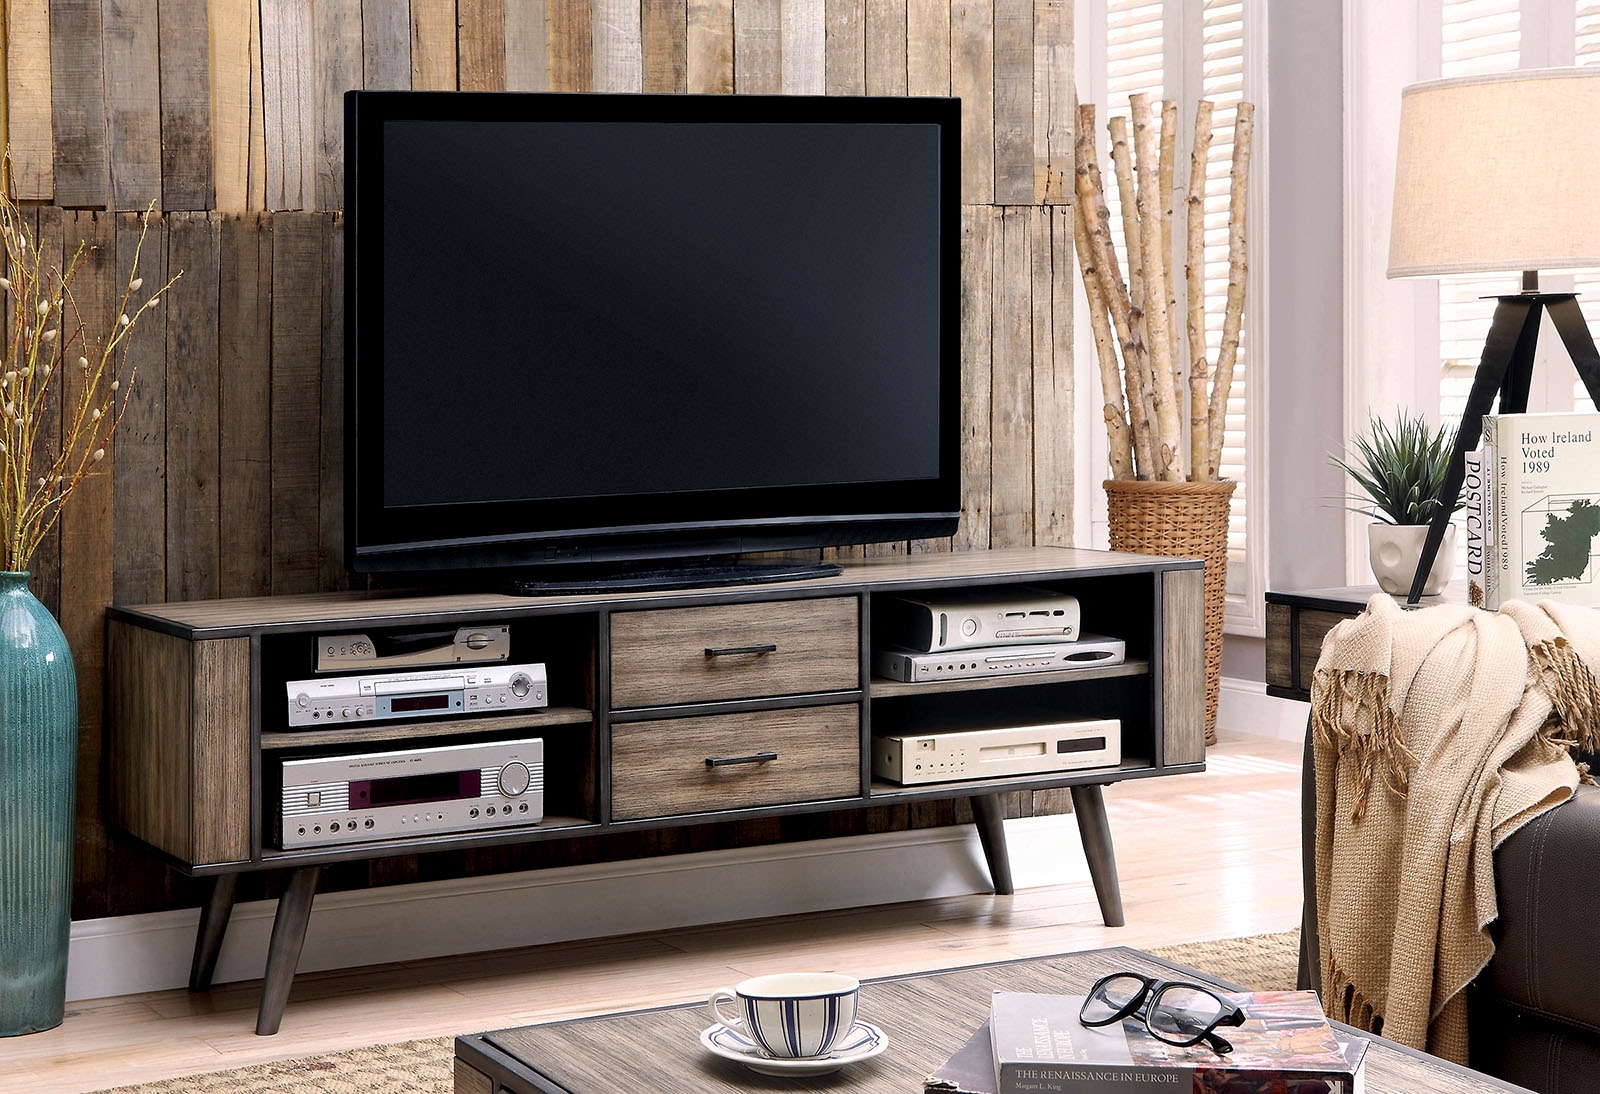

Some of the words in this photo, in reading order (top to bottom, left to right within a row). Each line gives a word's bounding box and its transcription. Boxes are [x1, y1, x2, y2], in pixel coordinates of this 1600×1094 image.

[1521, 432, 1547, 444] How
[1552, 430, 1592, 443] Ireland
[1521, 446, 1555, 458] Voted
[1523, 460, 1550, 473] 1989
[1466, 460, 1483, 575] POSTCARD
[1015, 1069, 1038, 1079] THE
[1040, 1070, 1119, 1082] RENAISSANCE
[1120, 1072, 1133, 1082] IN
[1135, 1072, 1179, 1083] EUROPE
[1047, 1084, 1062, 1092] King
